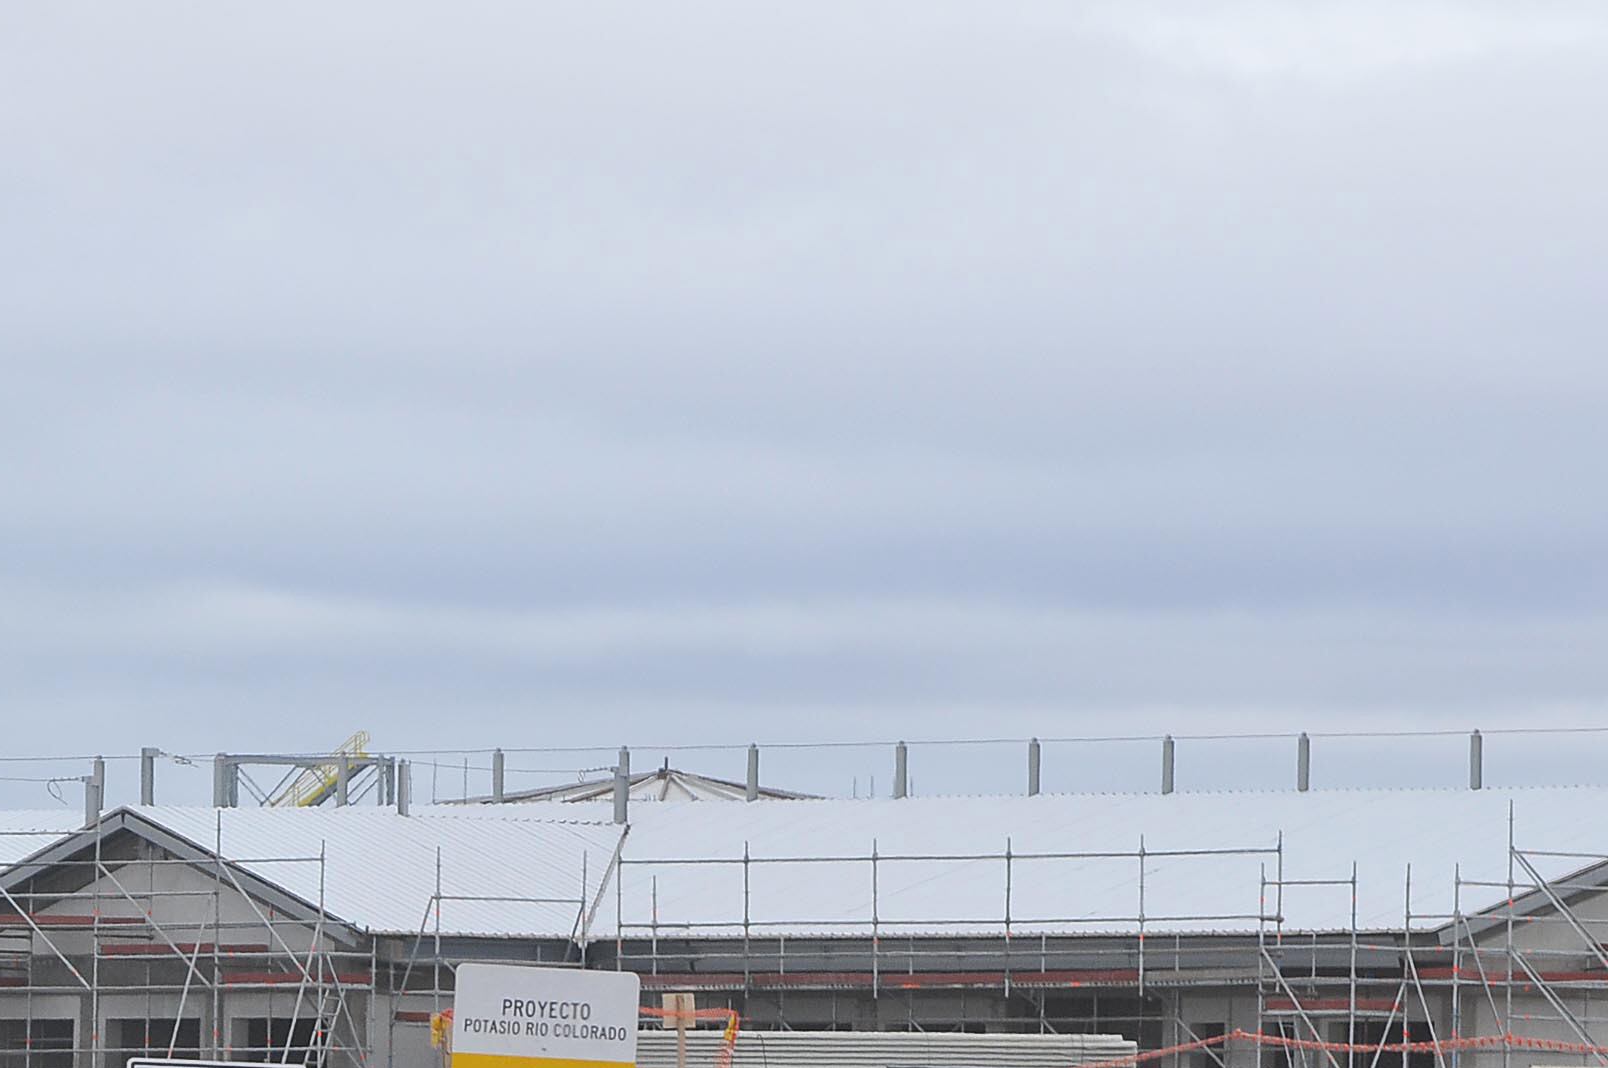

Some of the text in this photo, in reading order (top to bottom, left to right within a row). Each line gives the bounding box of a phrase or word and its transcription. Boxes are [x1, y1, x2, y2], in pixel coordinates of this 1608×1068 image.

[502, 998, 591, 1020] PROYECTO
[464, 1018, 626, 1041] POTASIO RIO COLORADO
